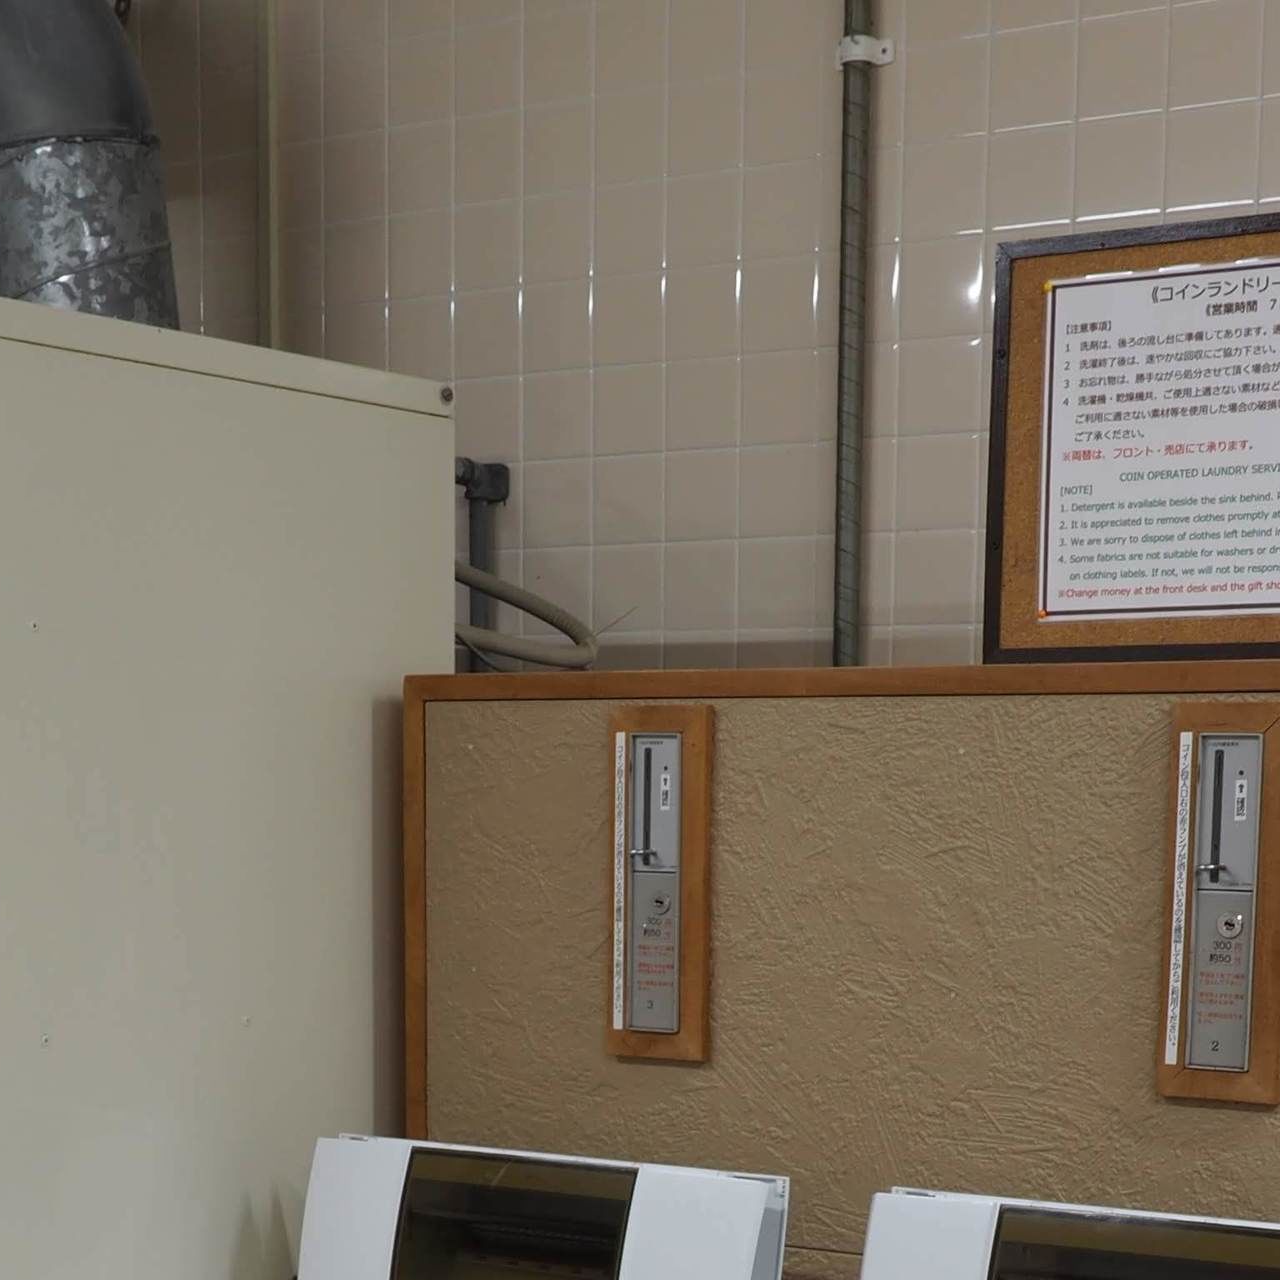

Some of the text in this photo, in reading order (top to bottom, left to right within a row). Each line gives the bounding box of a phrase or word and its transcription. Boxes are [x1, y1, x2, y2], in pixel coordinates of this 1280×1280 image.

[1118, 470, 1146, 483] COIN
[1146, 467, 1200, 481] OPERATED
[1200, 463, 1250, 478] LAUNDRY
[1059, 483, 1094, 498] [NOTE]
[1070, 501, 1116, 514] Detergent
[1116, 500, 1126, 511] is
[1126, 497, 1168, 510] available
[1168, 495, 1199, 508] beside
[1200, 495, 1217, 506] the
[1217, 493, 1238, 505] sink
[1238, 491, 1274, 504] behind.
[1070, 519, 1079, 530] It
[1079, 519, 1089, 530] is
[1089, 516, 1143, 531] appreciated
[1143, 516, 1155, 526] to
[1155, 515, 1191, 526] remove
[1192, 512, 1226, 524] clothes
[1226, 509, 1271, 524] promptly
[1069, 536, 1085, 547] We
[1086, 537, 1102, 546] are
[1103, 536, 1128, 546] sorry
[1128, 534, 1140, 545] to
[1140, 533, 1176, 545] dispose
[1188, 530, 1222, 541] clothes
[1222, 528, 1239, 540] left
[1240, 527, 1273, 539] behind
[1069, 553, 1095, 565] Some
[1095, 552, 1127, 563] fabrics
[1127, 552, 1144, 562] are
[1144, 550, 1162, 561] not
[1162, 548, 1199, 560] suitable
[1199, 547, 1215, 558] for
[1215, 546, 1255, 558] washers
[1081, 570, 1118, 582] clothing
[1119, 567, 1149, 579] labels.
[1160, 567, 1179, 578] not,
[1197, 565, 1214, 576] will
[1214, 565, 1232, 575] not
[1100, 588, 1132, 598] money
[1144, 585, 1161, 595] the
[1161, 583, 1185, 594] front
[1185, 583, 1208, 594] desk
[1210, 582, 1229, 593] and
[1229, 581, 1246, 592] the
[1247, 580, 1264, 593] gift
[1210, 1040, 1220, 1052] 2
